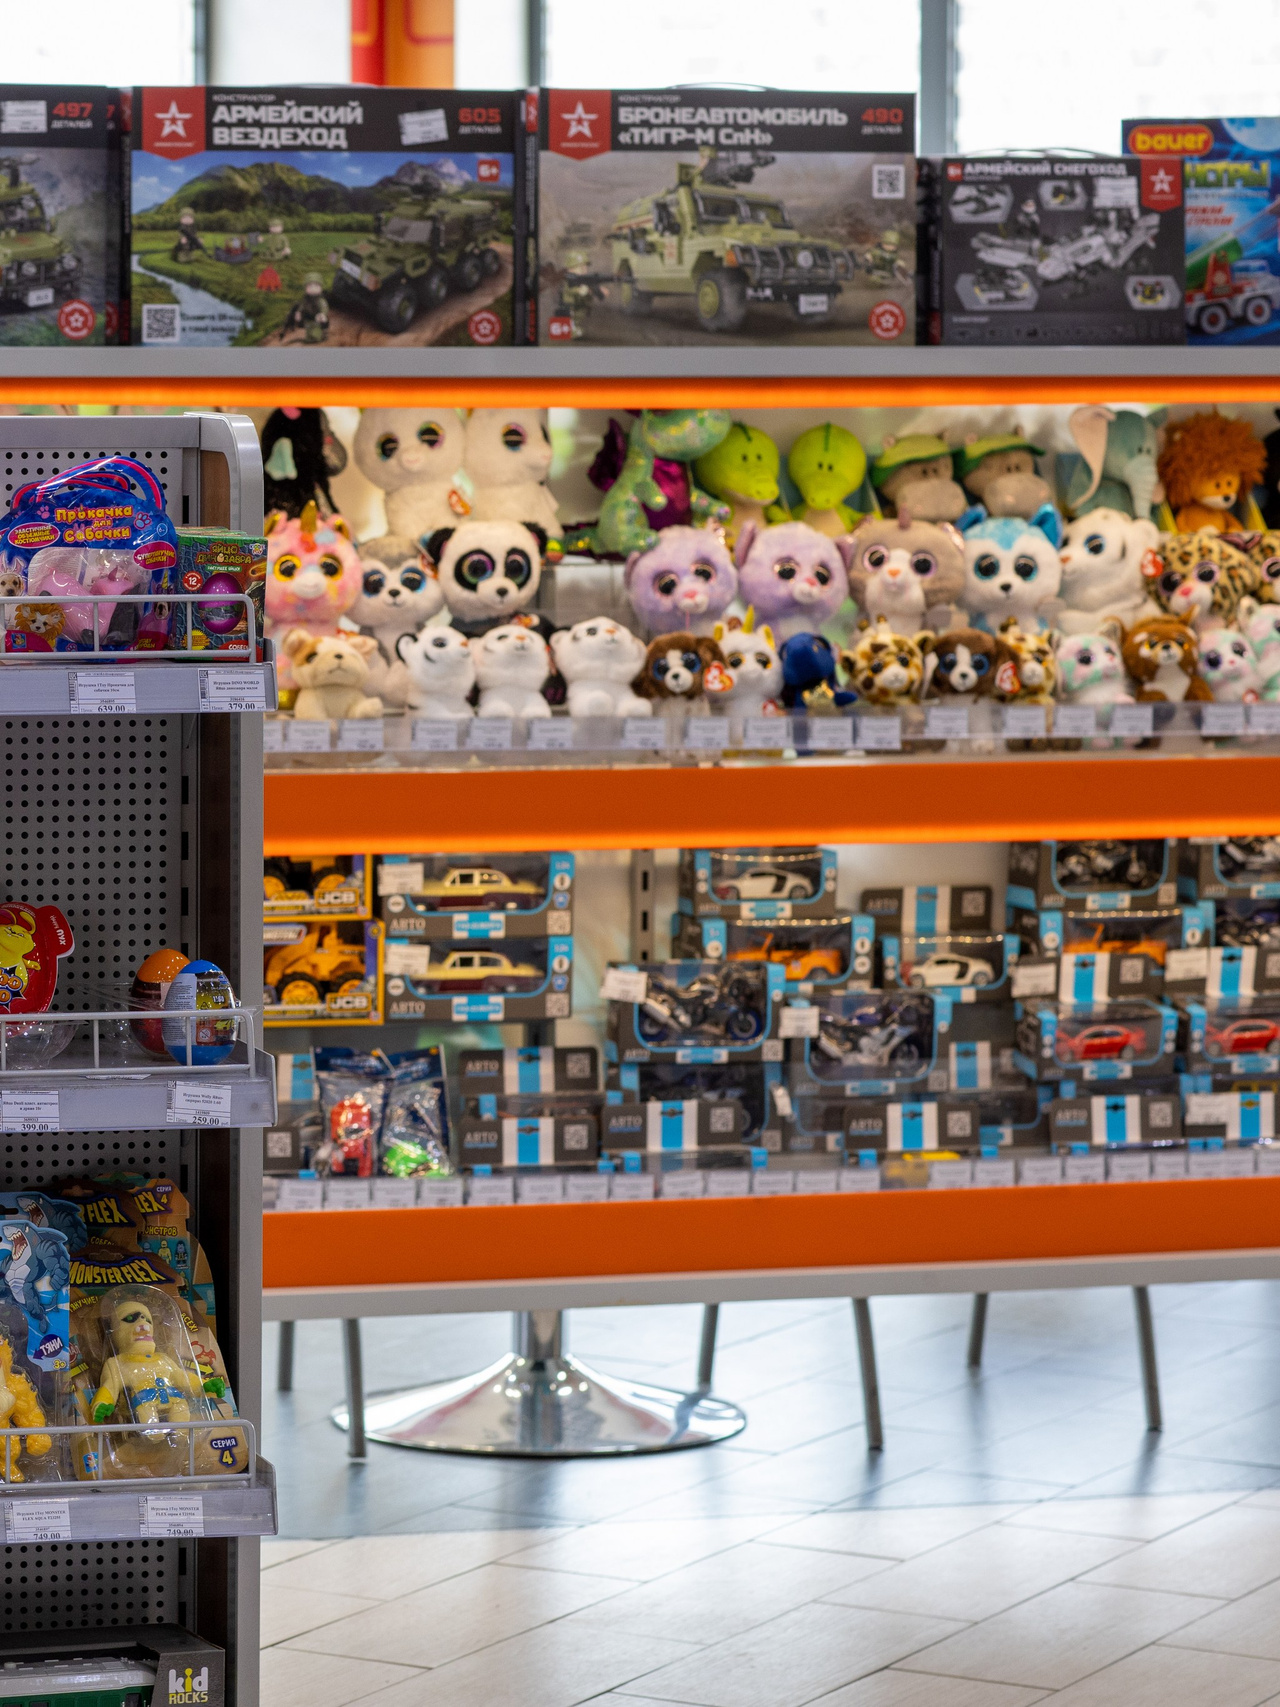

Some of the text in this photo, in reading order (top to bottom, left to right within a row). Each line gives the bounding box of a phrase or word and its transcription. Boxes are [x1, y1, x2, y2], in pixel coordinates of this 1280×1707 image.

[52, 102, 93, 118] 497
[212, 101, 363, 124] АРМЕЙСКИЙ
[458, 108, 501, 123] 605
[618, 107, 848, 126] БРОНЕАВТОМОБИЛЬ
[861, 108, 904, 124] 490
[212, 127, 348, 149] ВЕЗДЕХОД
[618, 128, 715, 146] «ТИГР-М
[1135, 127, 1210, 151] bauer
[478, 165, 500, 178] 6+
[964, 161, 1127, 177] АРМЕЙСКИЙ СНЕГОХОД
[549, 322, 572, 337] 6+
[56, 504, 134, 523] Прокачка
[93, 519, 113, 529] для
[63, 526, 132, 543] Собачки
[212, 544, 238, 554] ЯЙЦО
[188, 576, 197, 585] 12
[320, 891, 356, 905] JCB
[330, 996, 368, 1010] JCB
[193, 1116, 219, 1126] 259.00
[134, 1191, 165, 1213] LEX
[160, 1194, 168, 1204] 4
[125, 1259, 166, 1283] FLEX
[212, 1438, 236, 1448] СЕРИЯ
[222, 1450, 234, 1465] 4
[33, 1533, 61, 1541] 749.00
[167, 1529, 194, 1537] 749.00
[168, 1666, 209, 1693] kid
[168, 1691, 209, 1705] ROCKS
